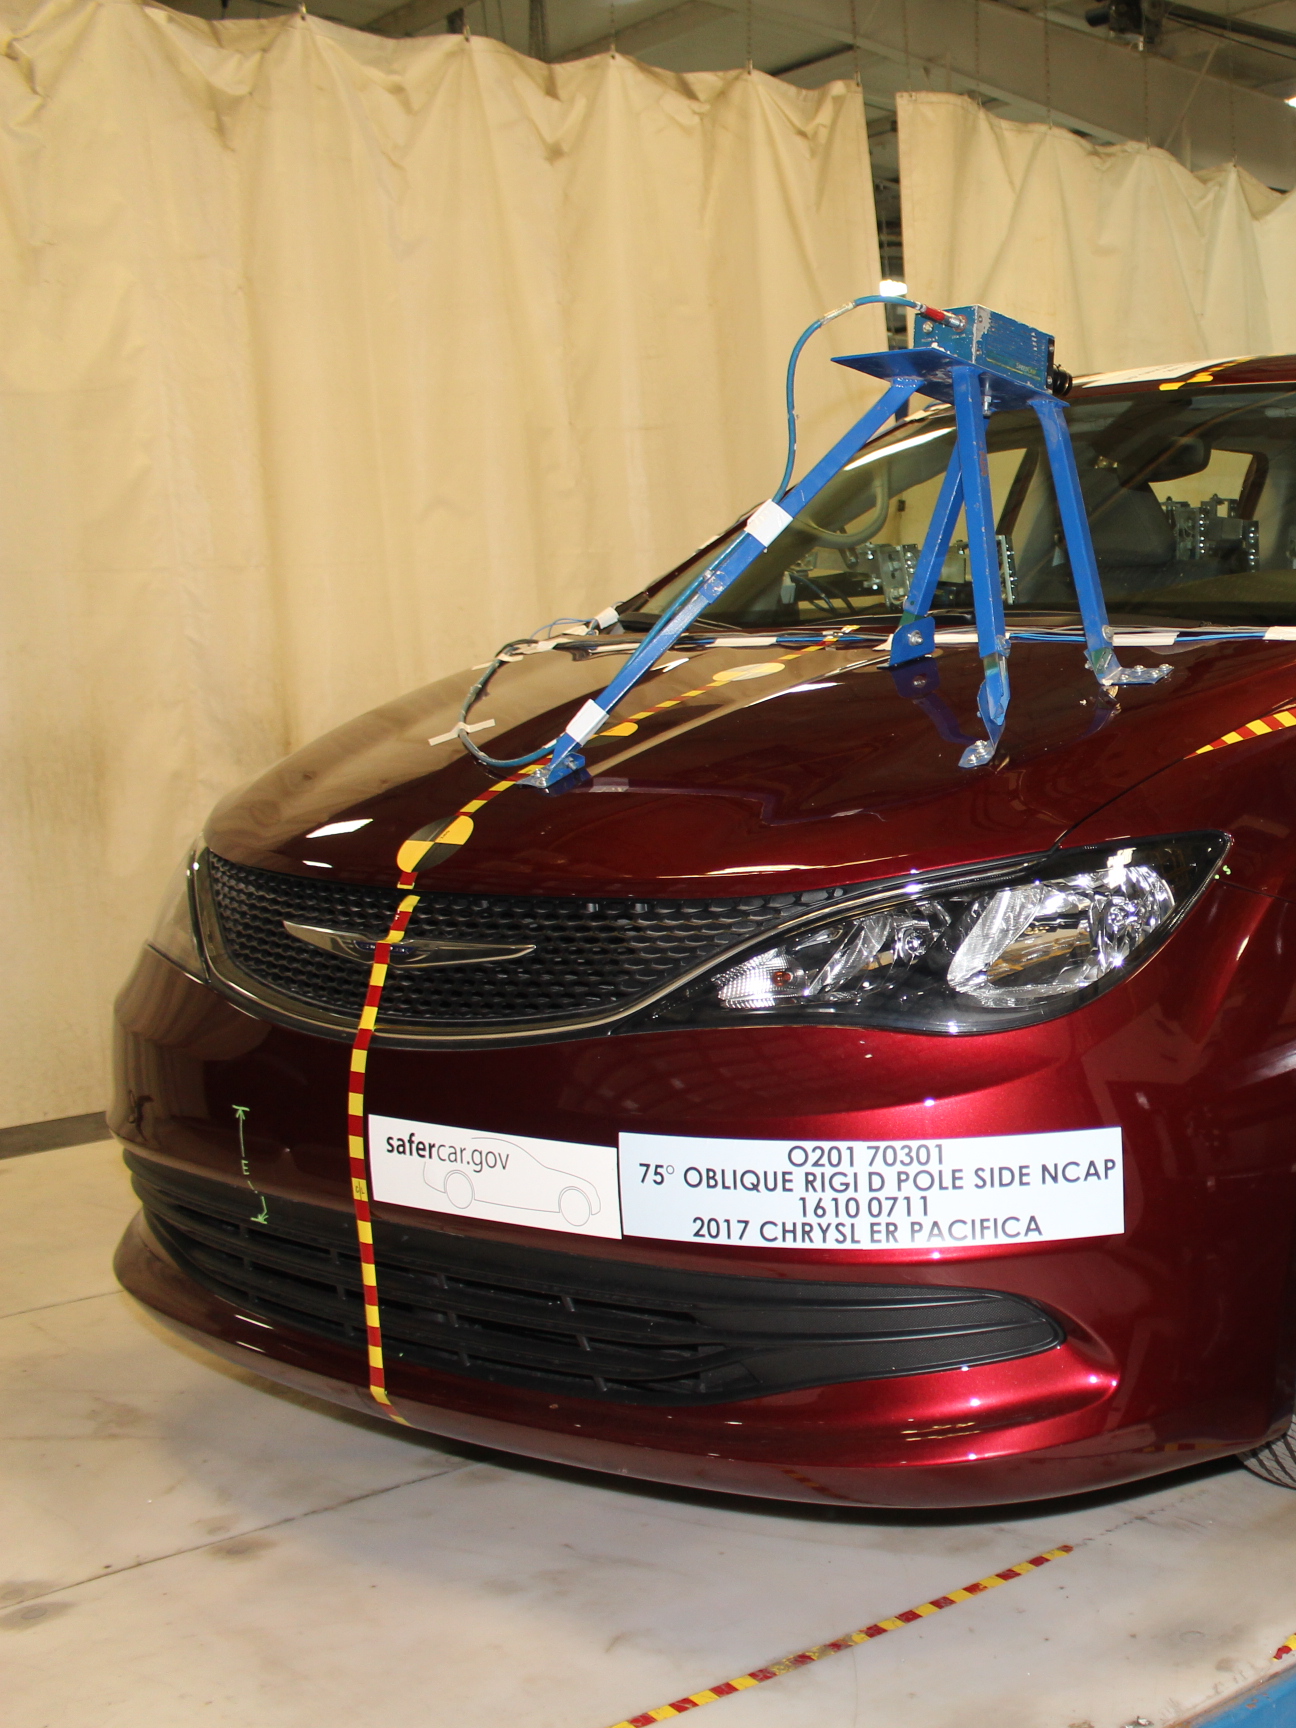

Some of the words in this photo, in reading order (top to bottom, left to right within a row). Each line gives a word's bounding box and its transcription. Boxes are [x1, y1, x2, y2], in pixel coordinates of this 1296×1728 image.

[241, 1159, 250, 1175] E
[386, 1132, 510, 1172] safercar.gov
[683, 1167, 794, 1193] OBLIQUE
[897, 1169, 963, 1192] POLE
[974, 1165, 1030, 1189] SIDE
[1041, 1158, 1117, 1185] NCAP
[692, 1216, 751, 1241] 2017
[910, 1215, 1043, 1243] PACIFICA
